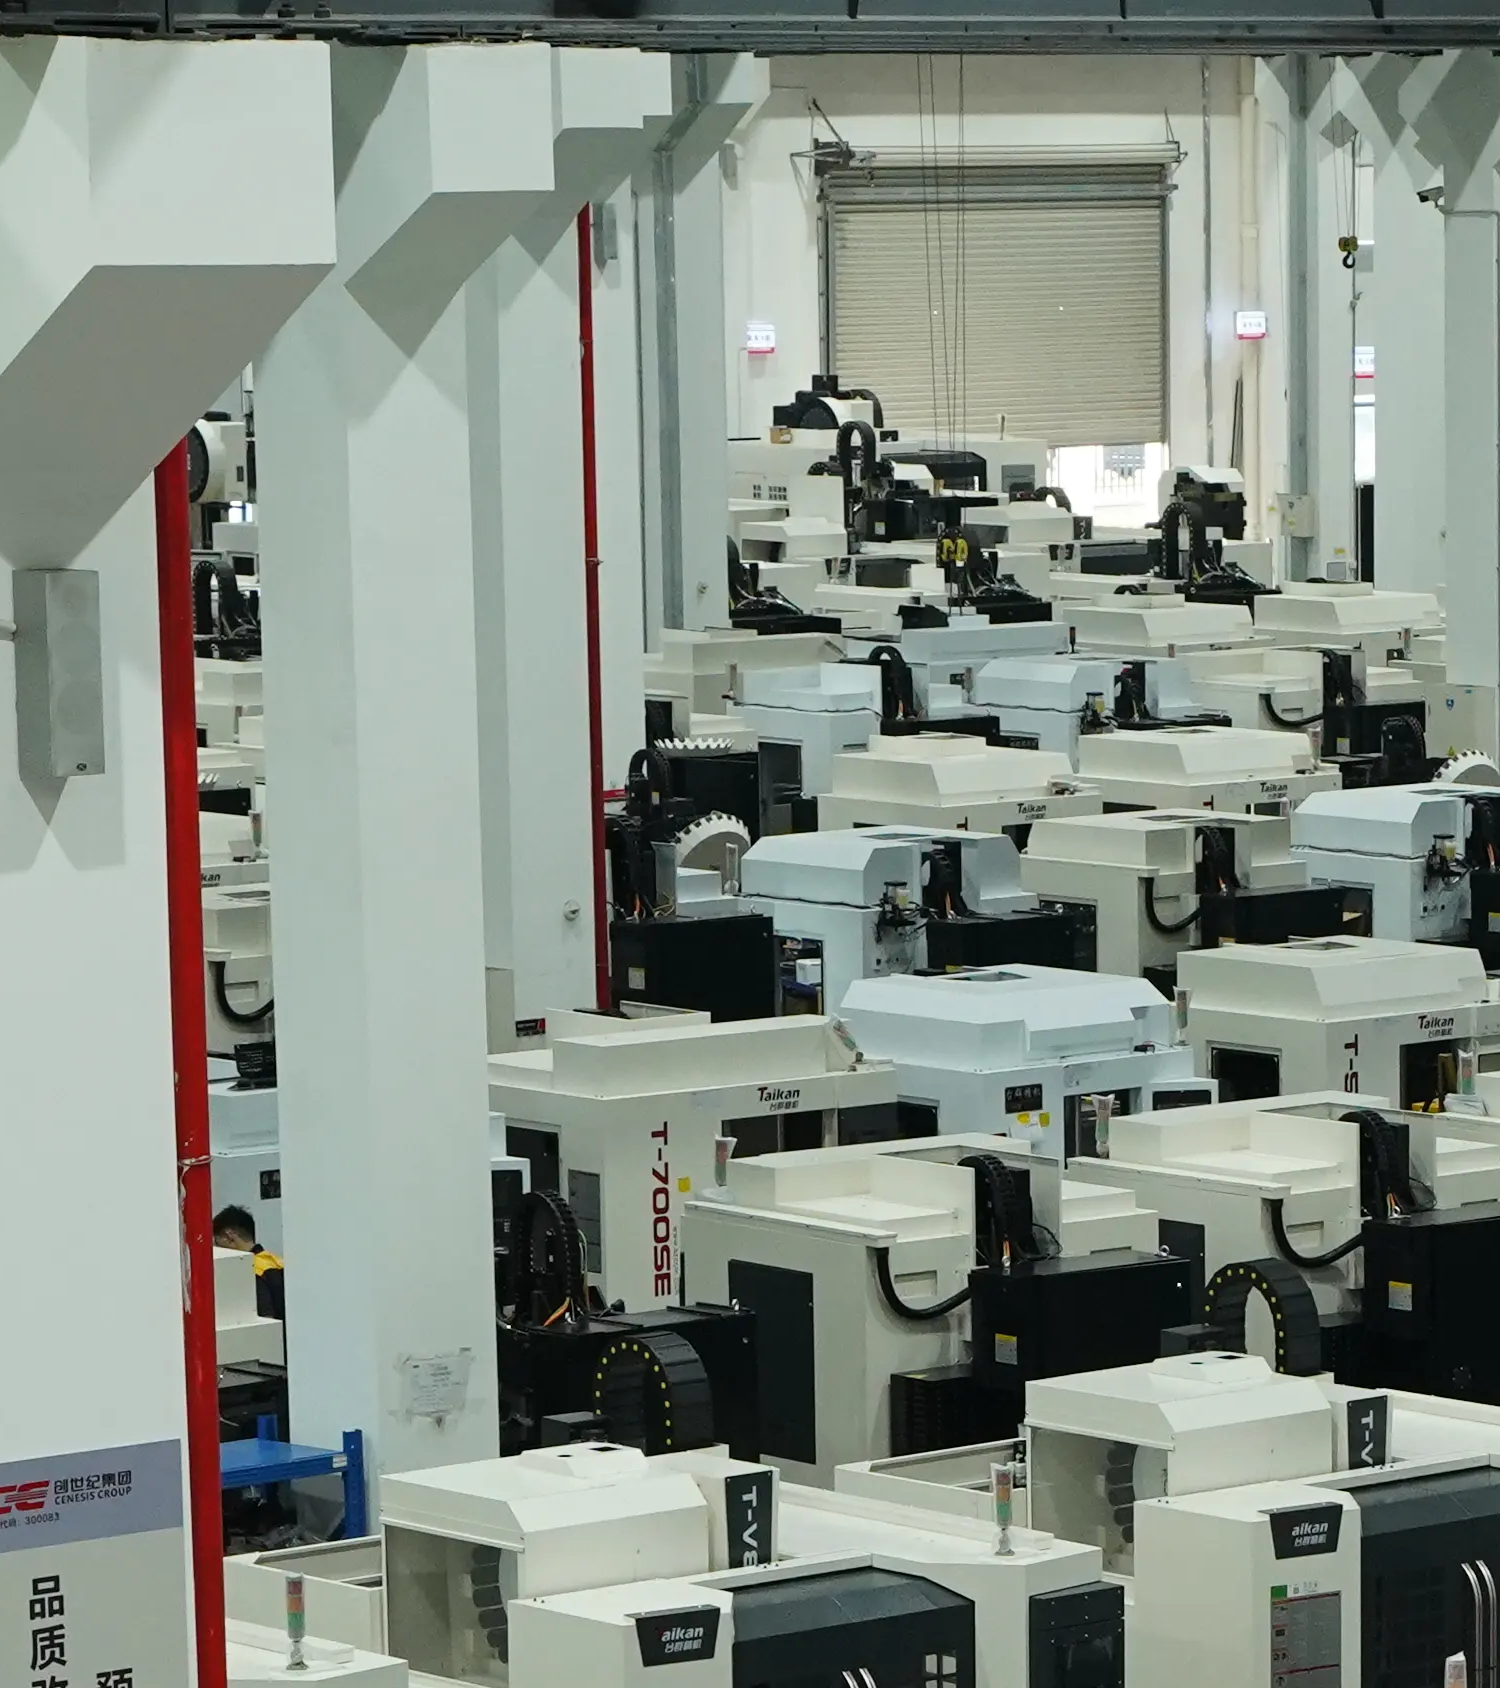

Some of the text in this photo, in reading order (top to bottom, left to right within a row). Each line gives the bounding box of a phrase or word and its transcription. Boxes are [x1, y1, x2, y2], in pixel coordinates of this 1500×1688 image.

[1418, 1015, 1454, 1030] Taikan
[757, 1087, 801, 1102] Taikan
[651, 1121, 672, 1297] T-700SE
[54, 1470, 132, 1495] 创世纪集团
